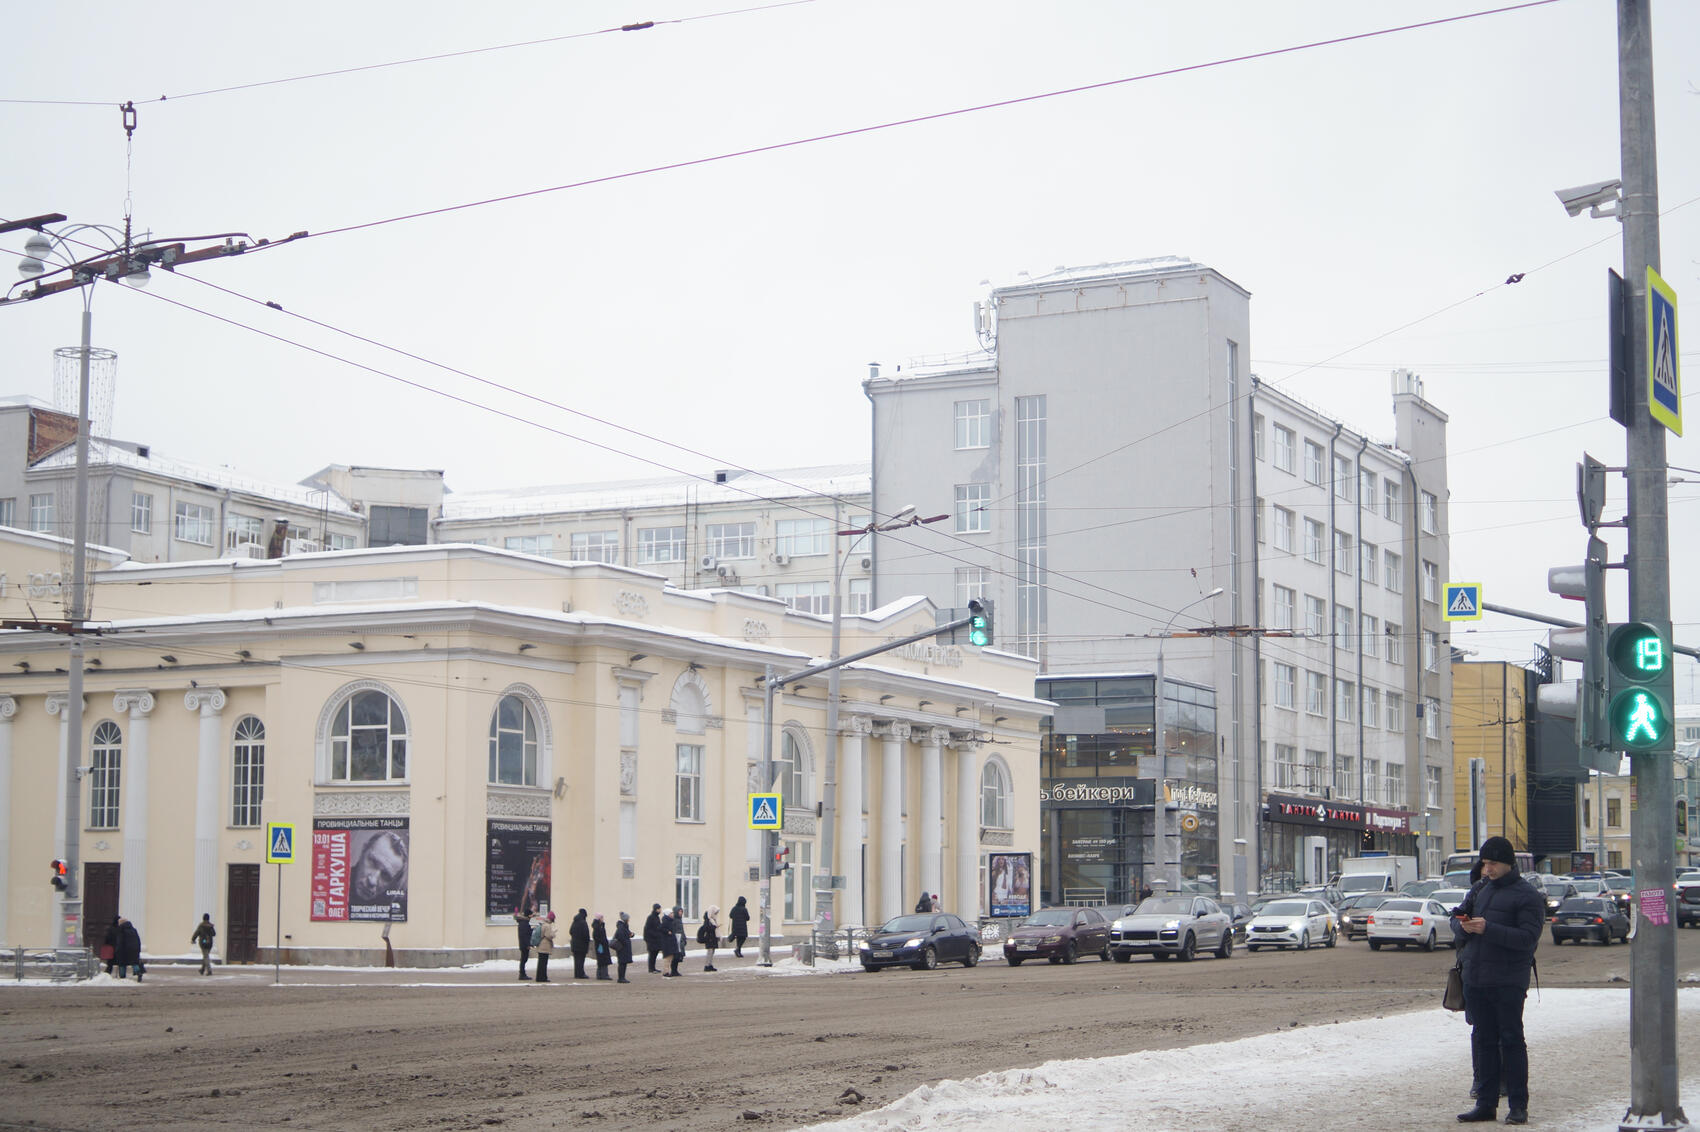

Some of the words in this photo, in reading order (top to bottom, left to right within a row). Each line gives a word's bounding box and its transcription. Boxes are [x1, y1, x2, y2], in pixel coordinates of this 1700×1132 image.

[1636, 638, 1662, 670] 19
[1053, 783, 1134, 804] бейкери
[317, 819, 379, 829] ПРОВИНЦИАЛЬНЫЕ
[380, 818, 404, 828] ТАНЦЫ
[329, 833, 346, 905] ГАРКУША
